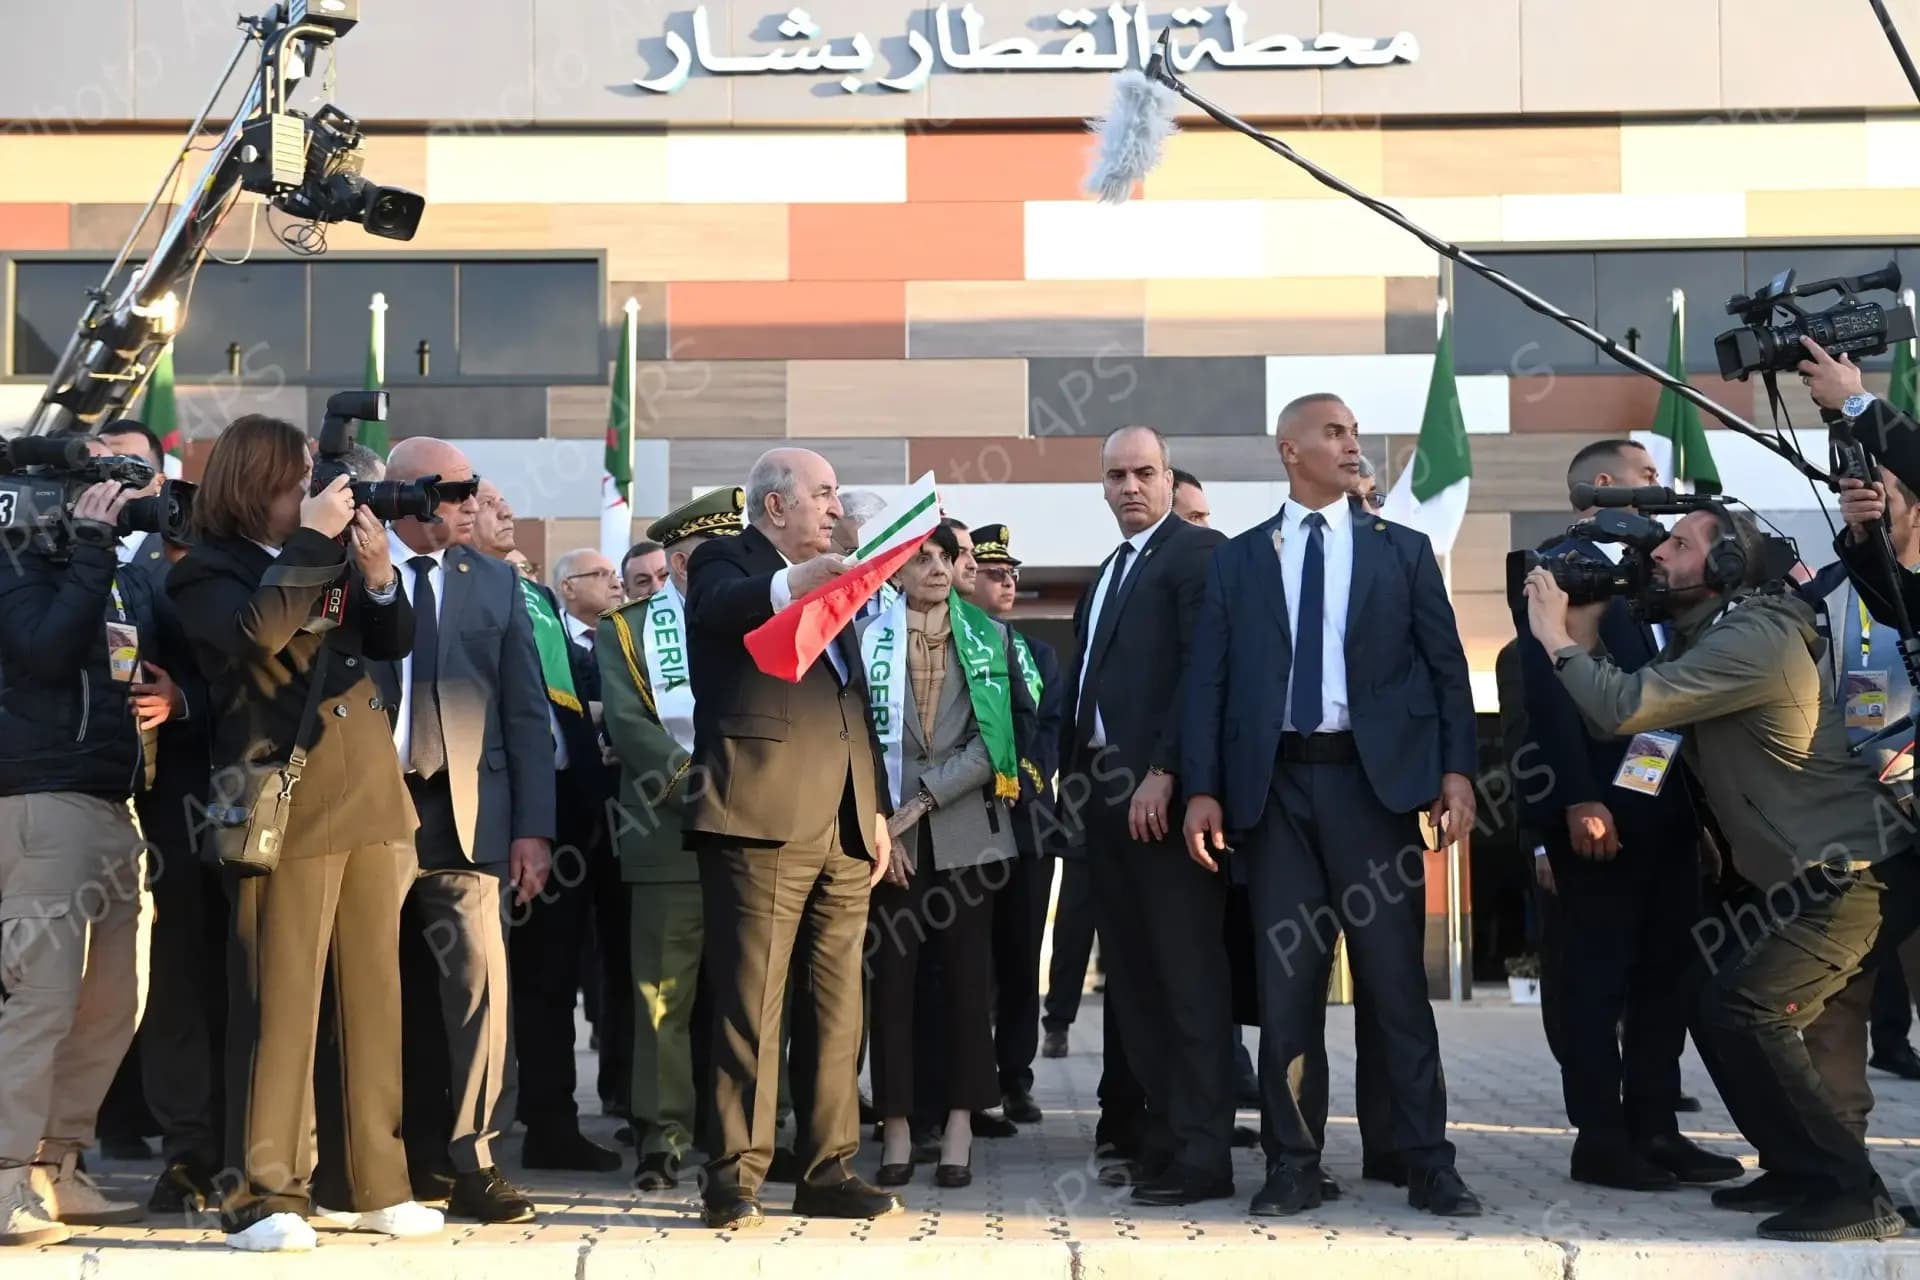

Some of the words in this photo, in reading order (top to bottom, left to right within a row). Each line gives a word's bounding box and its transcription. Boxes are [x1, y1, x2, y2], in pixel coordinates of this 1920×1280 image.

[632, 5, 875, 93] بشار
[876, 0, 1153, 92] القطار
[1171, 5, 1420, 72] محطة
[329, 588, 342, 614] EOS
[648, 594, 687, 693] LGERIA
